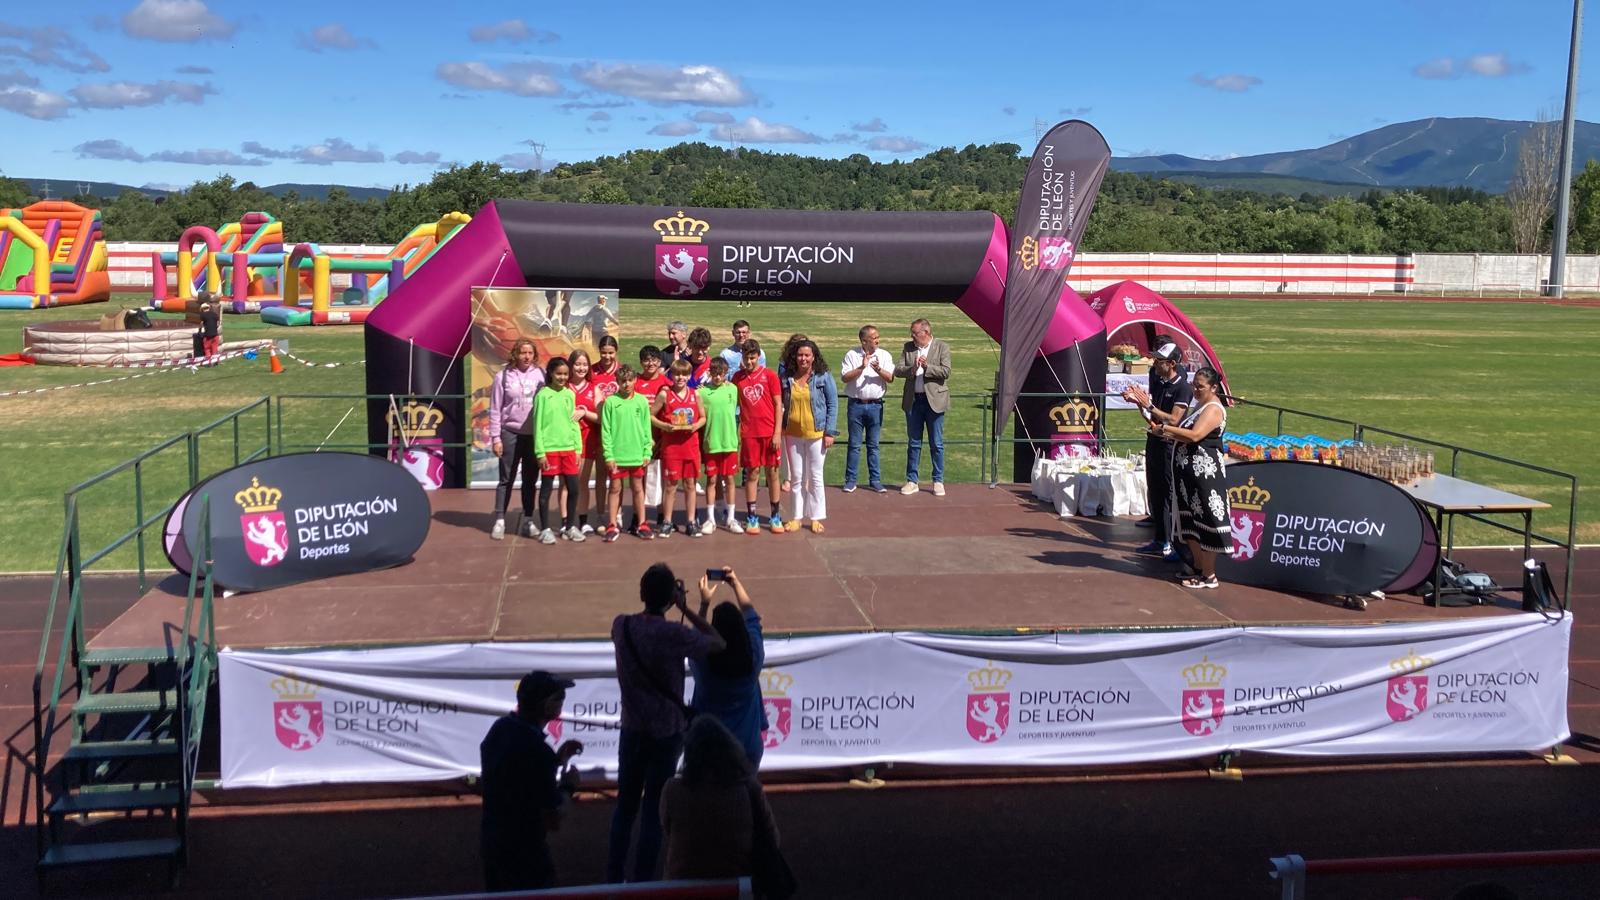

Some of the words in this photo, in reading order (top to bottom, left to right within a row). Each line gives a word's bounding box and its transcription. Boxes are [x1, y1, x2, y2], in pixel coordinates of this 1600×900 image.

[1040, 145, 1054, 230] DIPUTACIÓN
[1051, 172, 1064, 211] LEÓN
[1052, 213, 1063, 230] DE
[722, 242, 854, 264] DIPUTACIÓN
[722, 268, 749, 284] DE
[755, 265, 812, 285] LEÓN
[720, 287, 783, 297] Deportes
[294, 495, 398, 524] DIPUTACIÓN
[297, 526, 320, 543] DE
[324, 518, 369, 540] LEÓN
[1275, 514, 1386, 537] DIPUTACIÓN
[300, 543, 350, 559] Deportes
[1272, 533, 1295, 548] DE
[1298, 533, 1345, 553] LEÓN
[1270, 551, 1321, 567] Deportes
[1437, 668, 1540, 688] DIPUTACIÓN
[801, 691, 915, 711] DIPUTACIÓN
[1020, 686, 1131, 706] DIPUTACIÓN
[1234, 681, 1343, 701] DIPUTACIÓN
[1436, 691, 1457, 705] DE
[1460, 685, 1507, 704] LEÓN
[1019, 709, 1041, 723] DE
[1047, 705, 1094, 722] LEÓN
[1232, 705, 1257, 716] DE
[335, 718, 360, 731] DE
[366, 715, 419, 732] LEÓN
[801, 715, 824, 731] DE
[830, 711, 879, 730] LEÓN
[1232, 724, 1266, 732] DEPORTES
[1272, 722, 1306, 731] JUVENTUD
[801, 739, 837, 747] DEPORTES
[844, 739, 880, 748] JUVENTUD
[1018, 731, 1053, 740] DEPORTES
[1060, 731, 1096, 739] JUVENTUD
